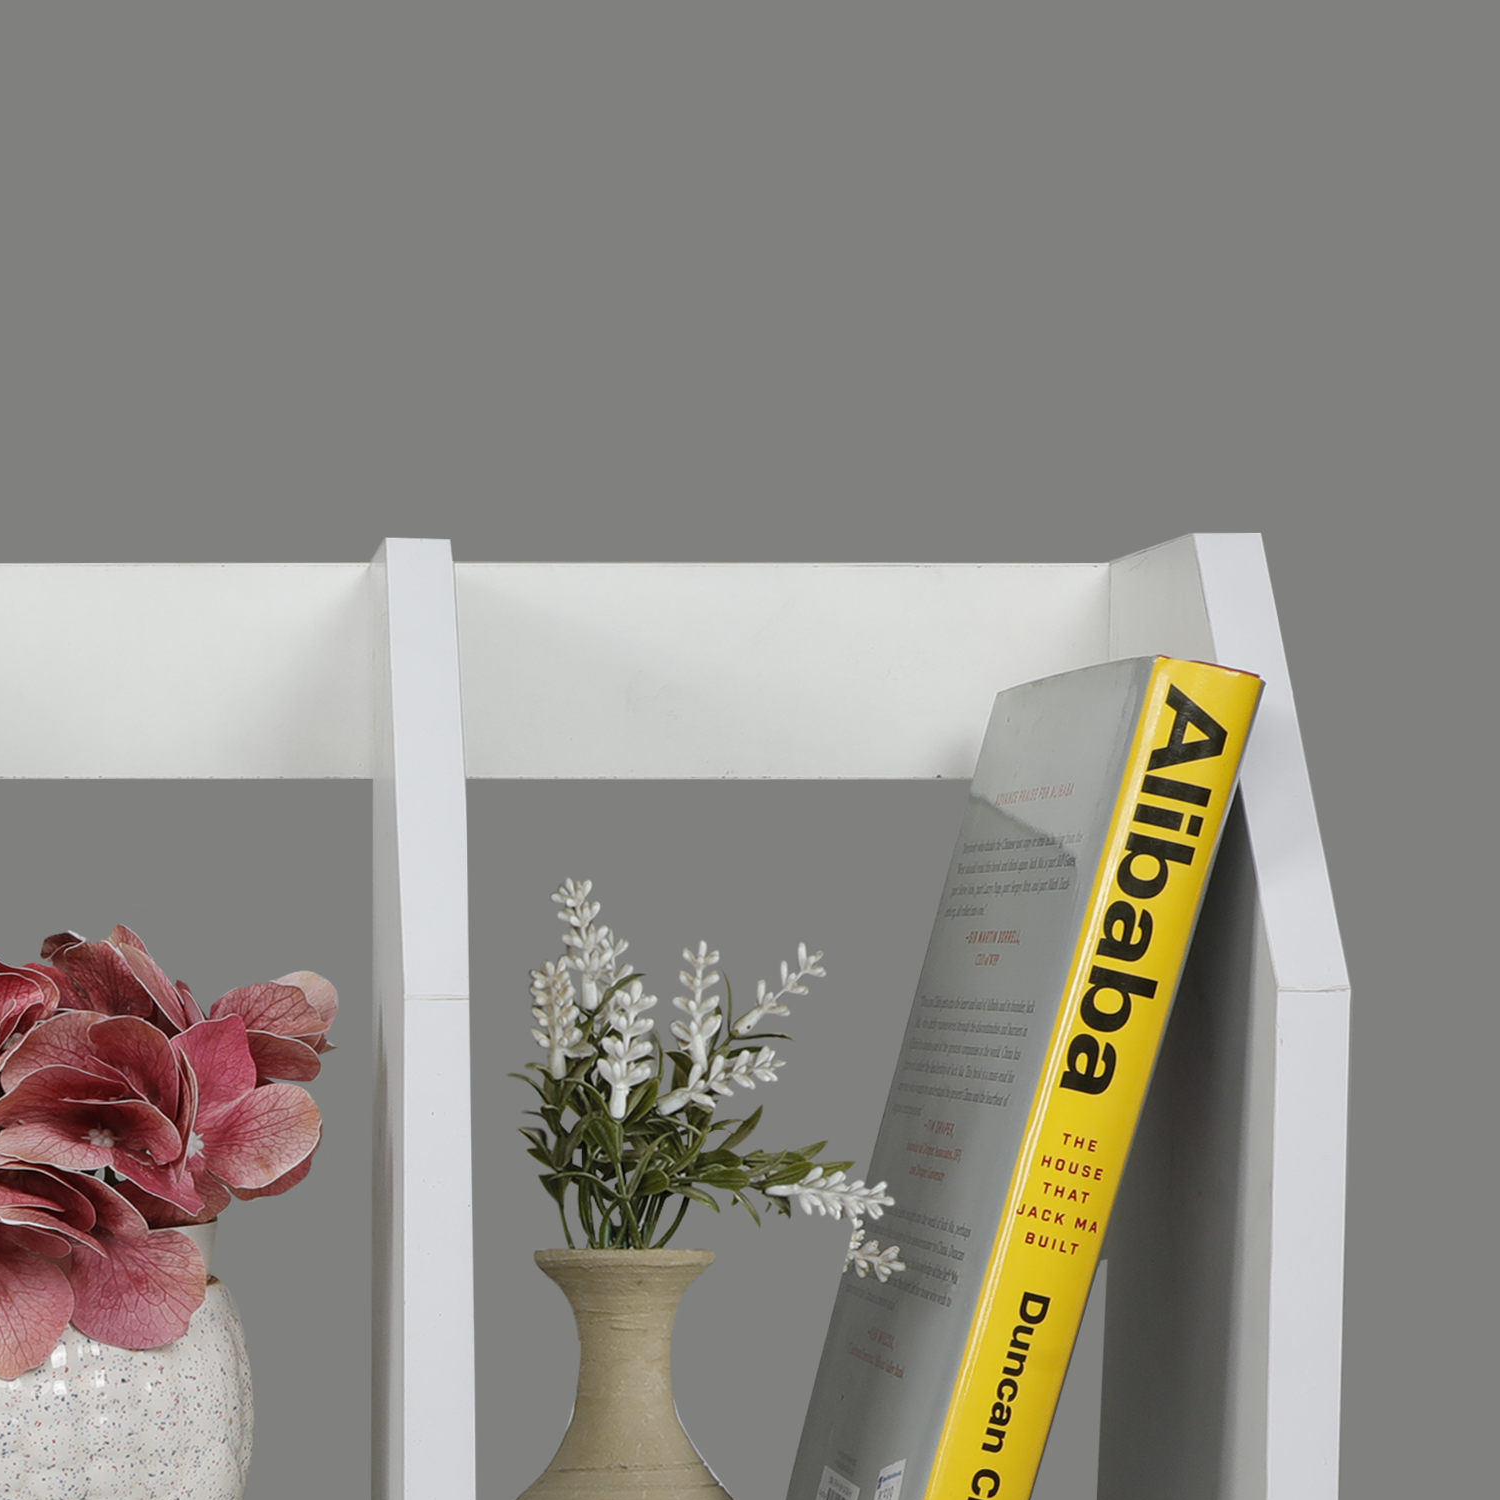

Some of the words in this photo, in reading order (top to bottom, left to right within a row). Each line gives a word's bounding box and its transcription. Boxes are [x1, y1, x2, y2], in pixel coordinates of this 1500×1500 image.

[1058, 683, 1229, 1097] Alibaba
[1062, 1132, 1098, 1152] THE
[1040, 1154, 1104, 1180] HOUSE
[1042, 1182, 1090, 1204] THAT
[1016, 1204, 1066, 1226] JACK
[1074, 1217, 1098, 1234] MA
[1024, 1232, 1080, 1255] BUILT
[981, 1290, 1052, 1454] Duncan
